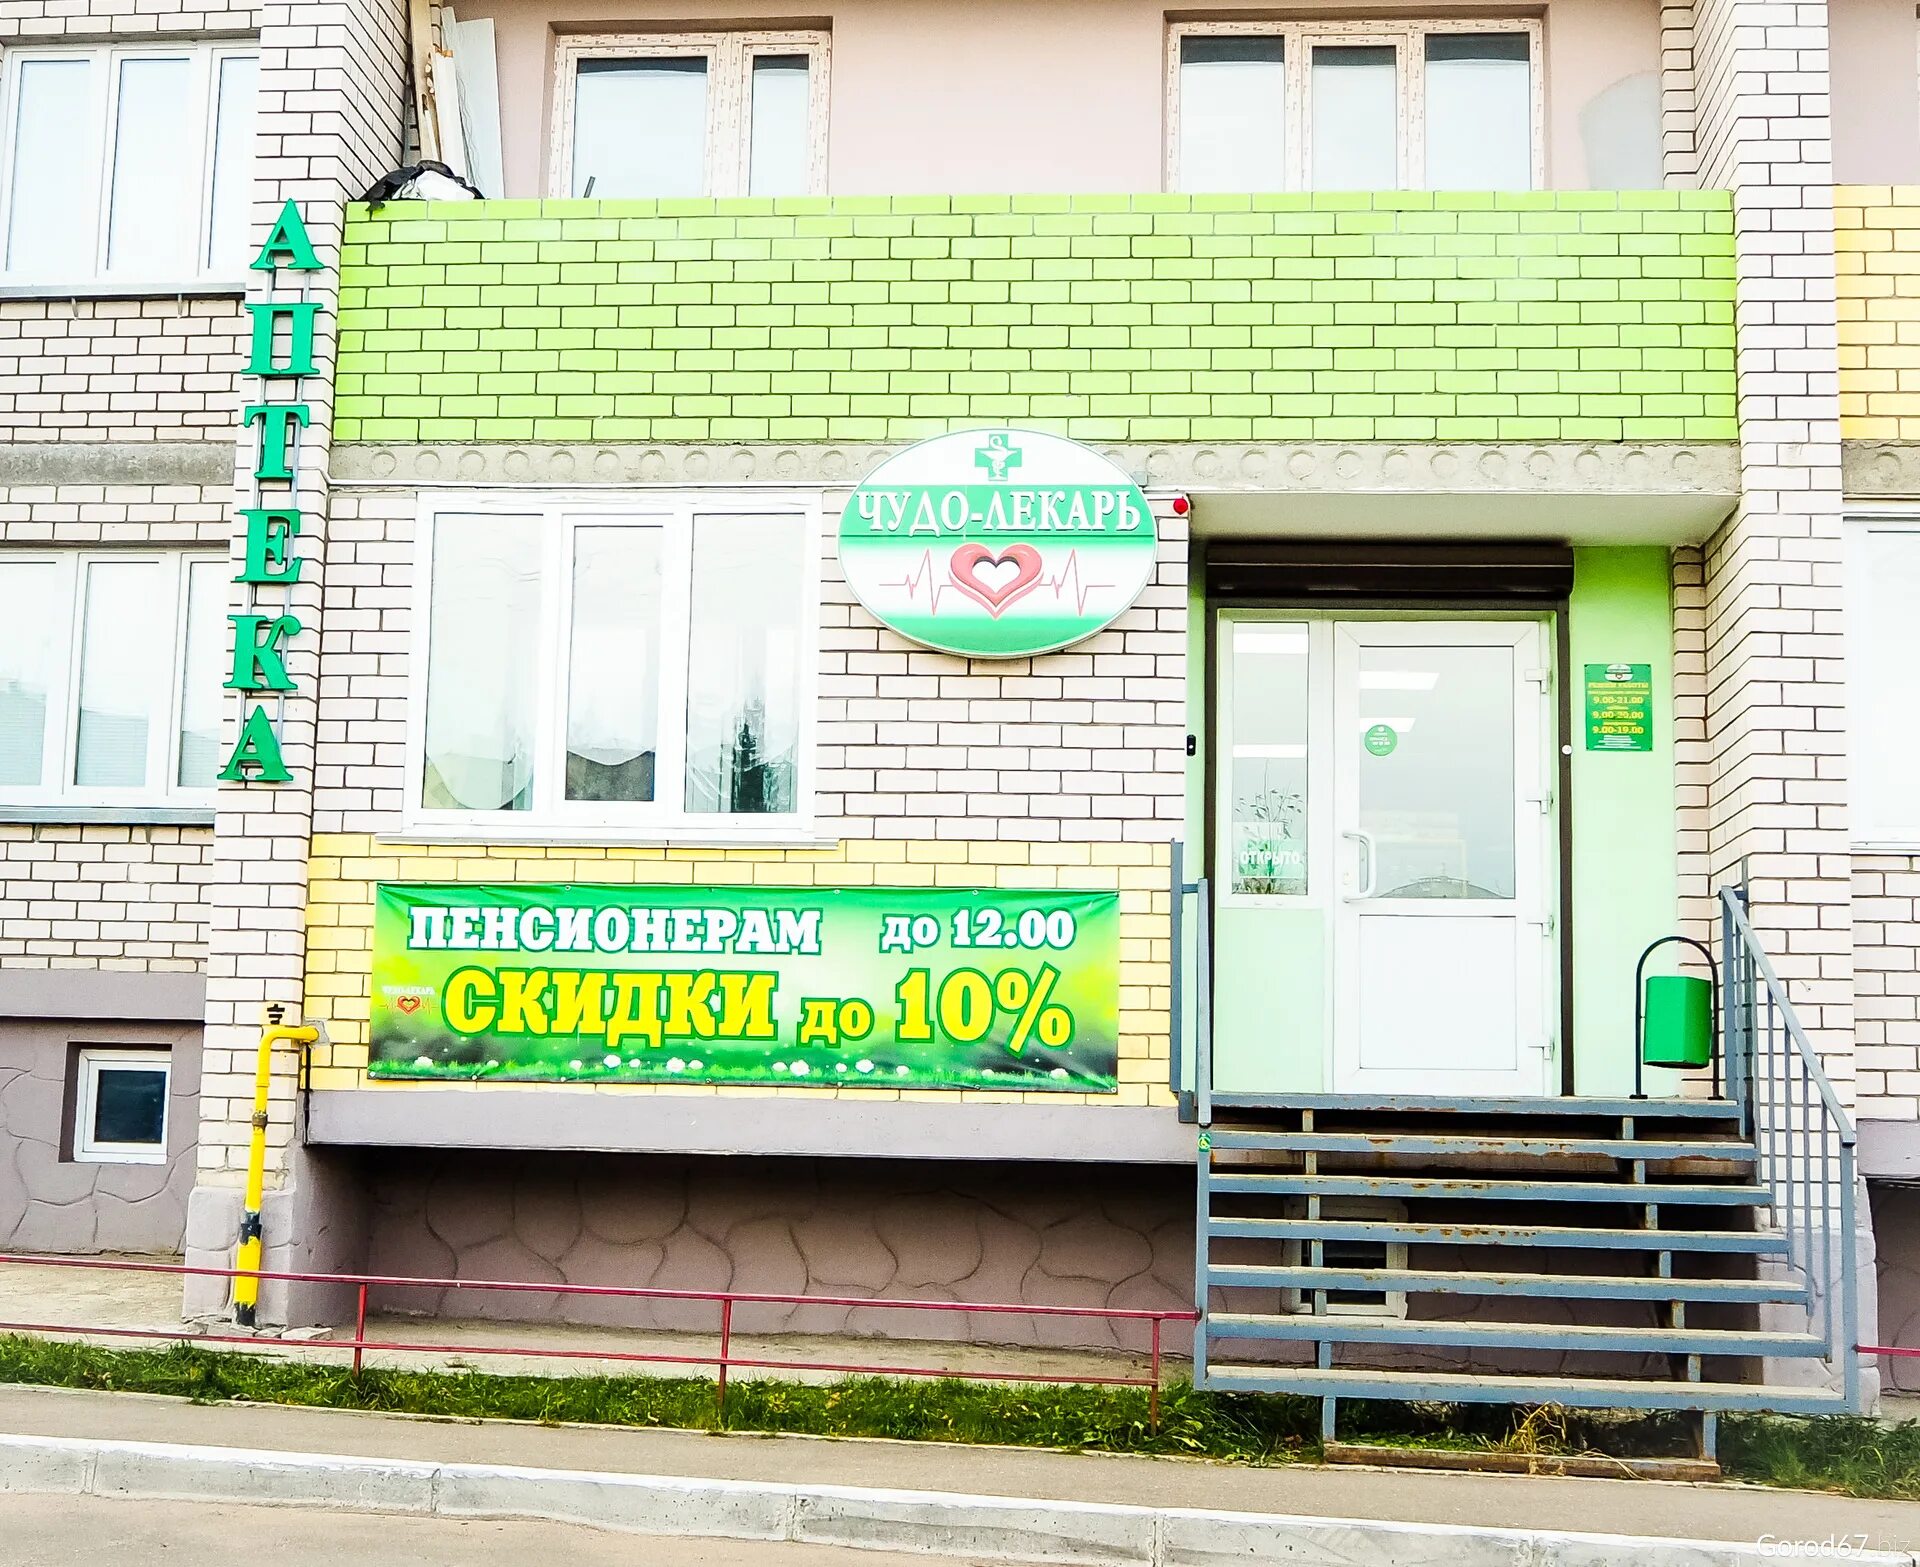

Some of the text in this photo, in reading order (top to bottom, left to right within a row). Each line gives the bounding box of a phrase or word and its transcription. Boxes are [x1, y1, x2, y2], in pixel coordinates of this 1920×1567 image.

[216, 197, 325, 784] АПТЕКА
[855, 488, 1143, 538] ЧУДО-ЛЕКАРЬ
[1592, 726, 1644, 734] 9.00-19.00
[1240, 850, 1301, 865] ОТКРЫТО
[407, 905, 823, 955] ПЕНСИОНЕРАМ
[879, 906, 1077, 953] до 12.00
[441, 961, 1075, 1059] СКИДКИ до 10%
